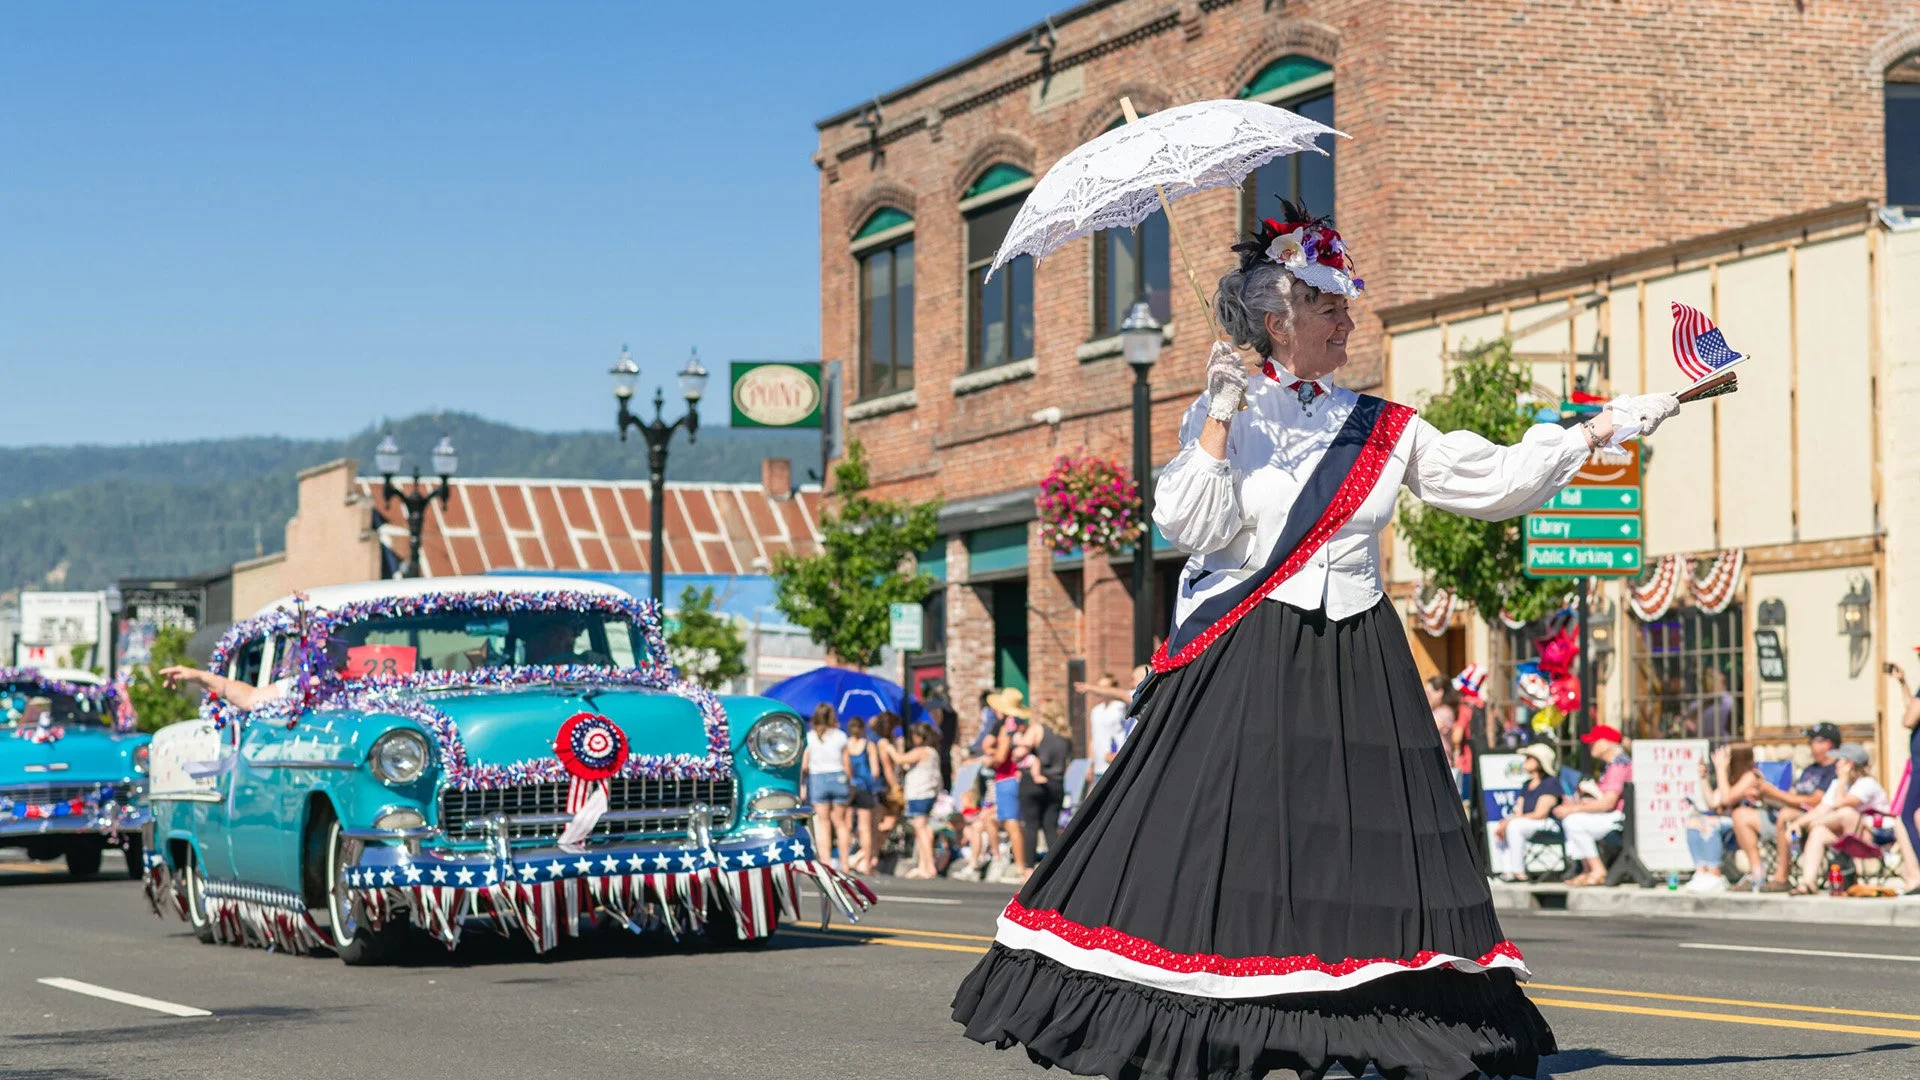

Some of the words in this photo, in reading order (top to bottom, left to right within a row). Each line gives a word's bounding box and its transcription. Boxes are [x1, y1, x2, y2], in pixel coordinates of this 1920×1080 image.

[1561, 489, 1582, 506] Hall
[1532, 518, 1571, 539] Library
[1530, 547, 1565, 566] Public
[1569, 547, 1613, 569] Parking
[363, 657, 398, 678] 28
